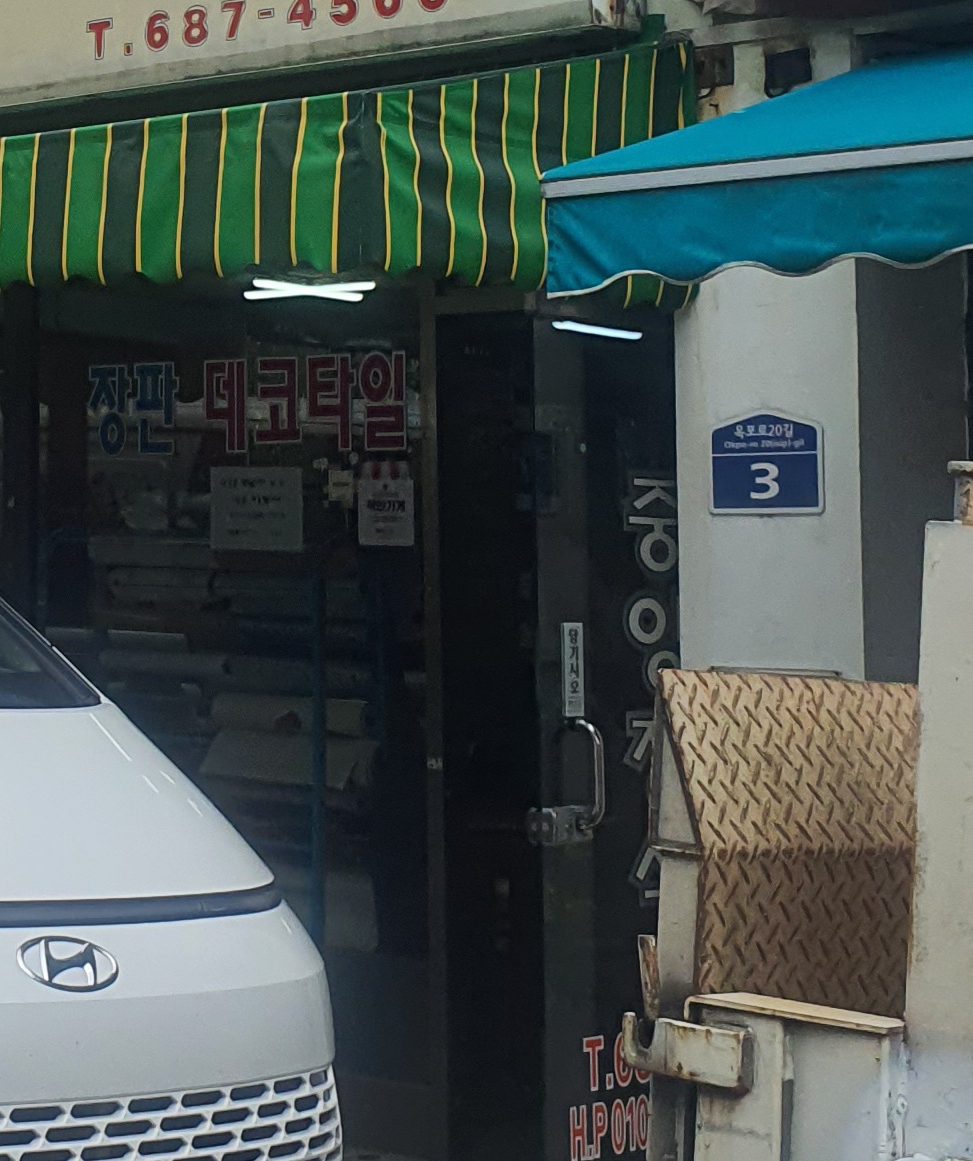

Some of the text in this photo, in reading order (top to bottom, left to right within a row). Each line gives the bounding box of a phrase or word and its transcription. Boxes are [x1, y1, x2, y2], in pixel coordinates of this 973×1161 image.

[87, 349, 408, 457] 장판 데코타일
[748, 461, 781, 501] 3
